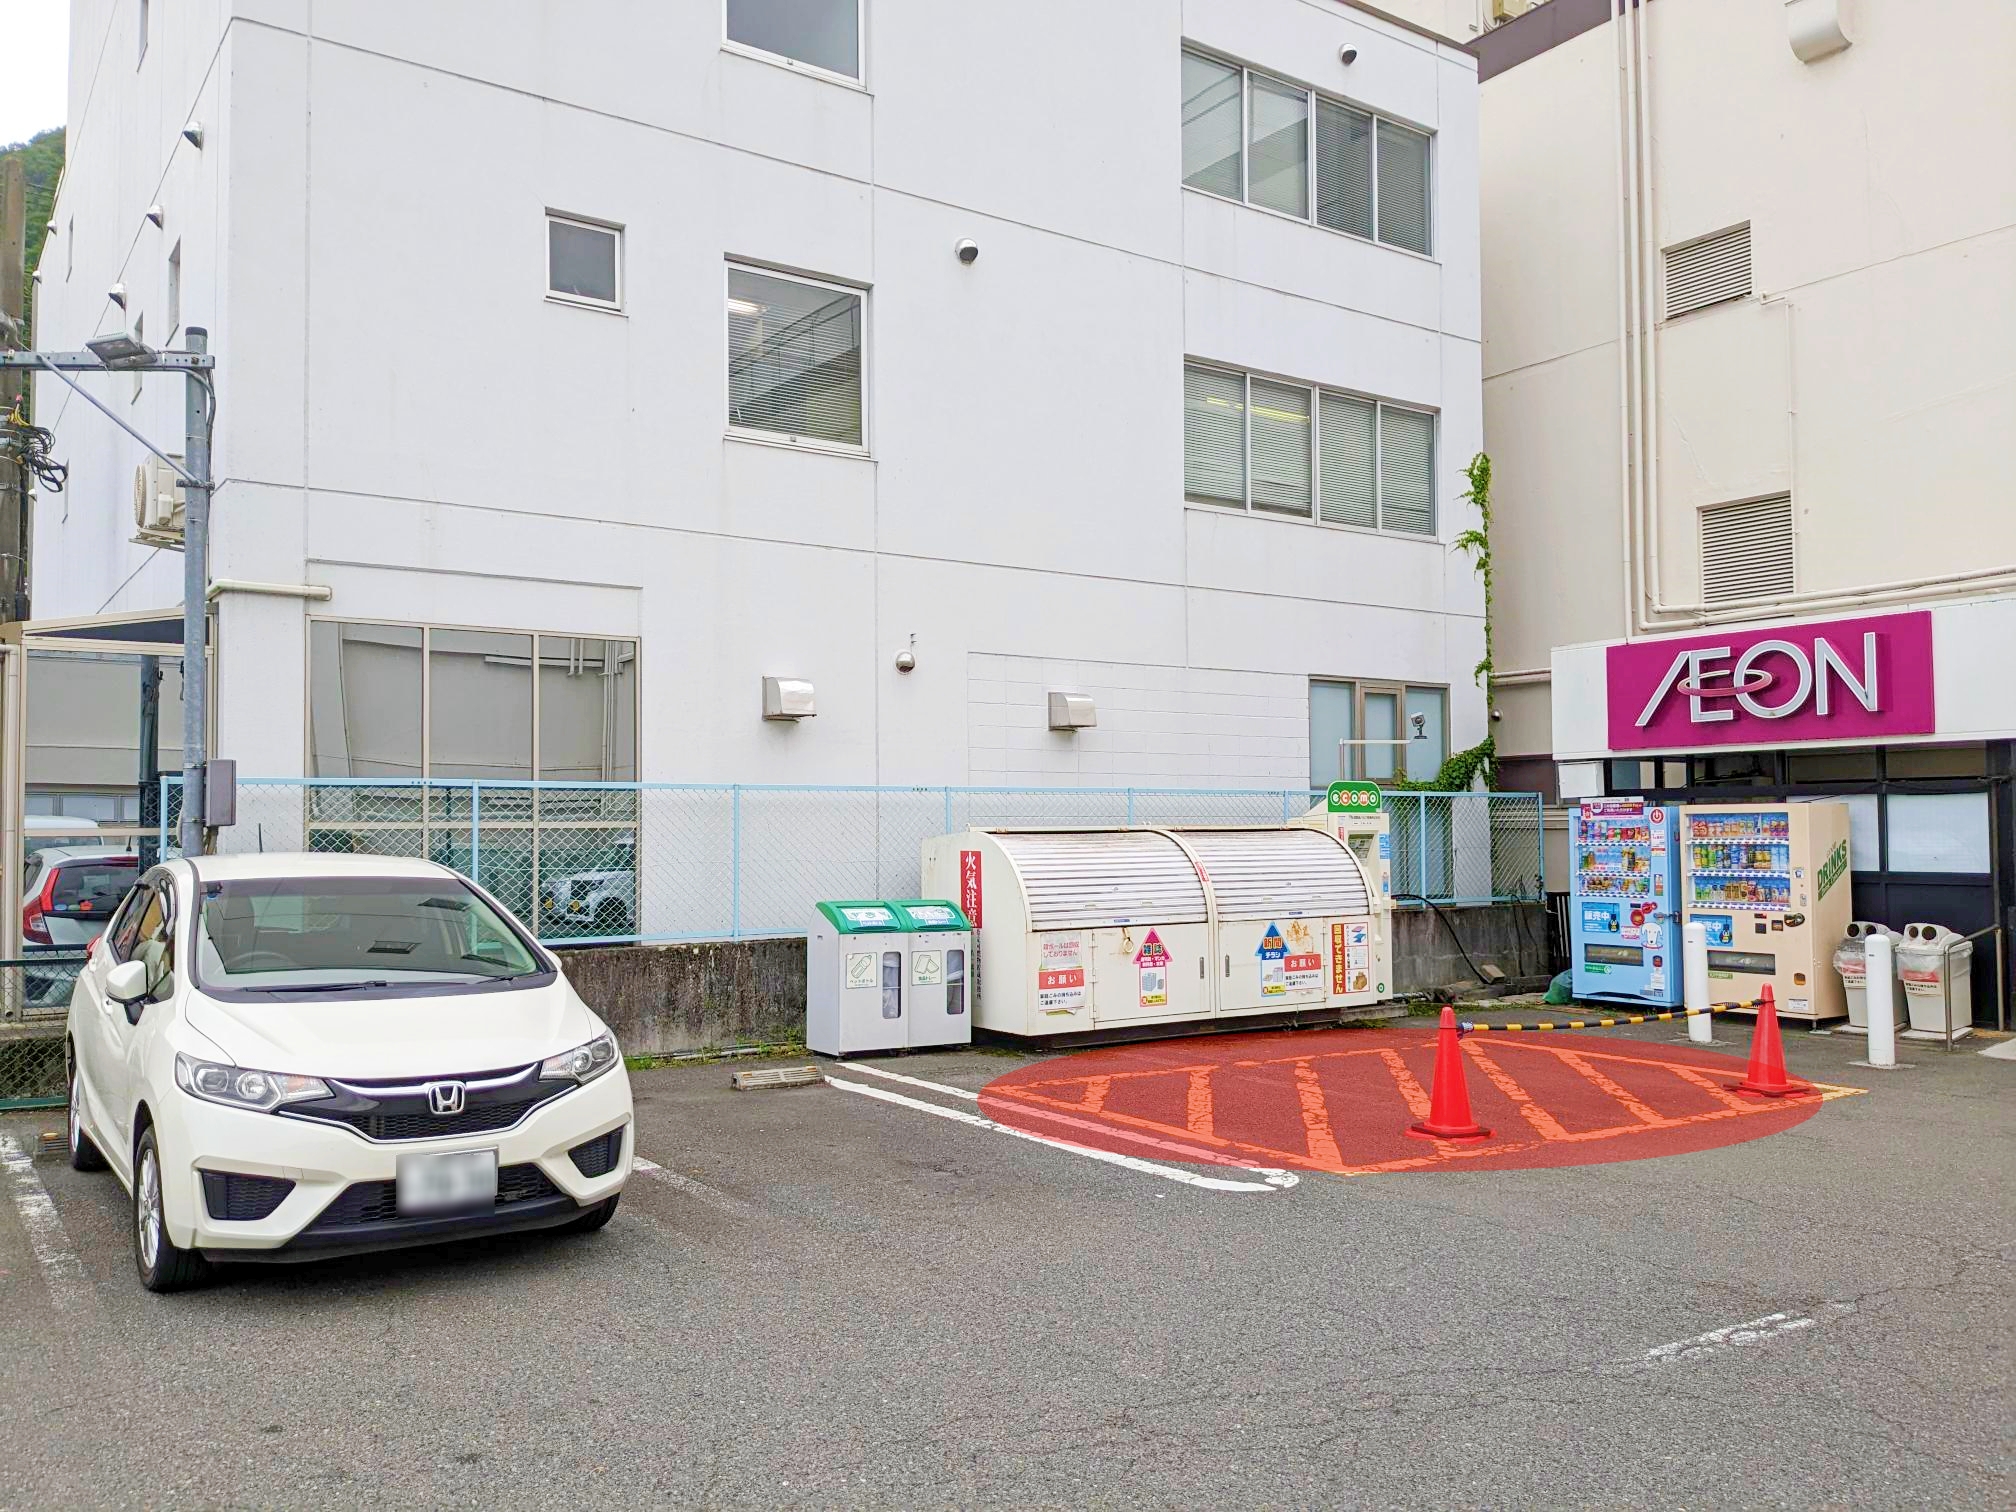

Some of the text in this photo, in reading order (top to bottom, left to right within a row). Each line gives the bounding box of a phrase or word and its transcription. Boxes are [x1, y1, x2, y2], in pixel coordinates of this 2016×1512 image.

[1330, 790, 1378, 806] ecomo
[1817, 839, 1847, 891] DRINKS
[965, 851, 977, 927] 火気注意
[1263, 936, 1283, 949] 新聞
[1043, 950, 1077, 958] しておりません
[1143, 943, 1163, 956] 雑誌
[1265, 951, 1281, 959] チラシ
[1333, 924, 1343, 994] 回収できません
[1048, 974, 1077, 985] お願い
